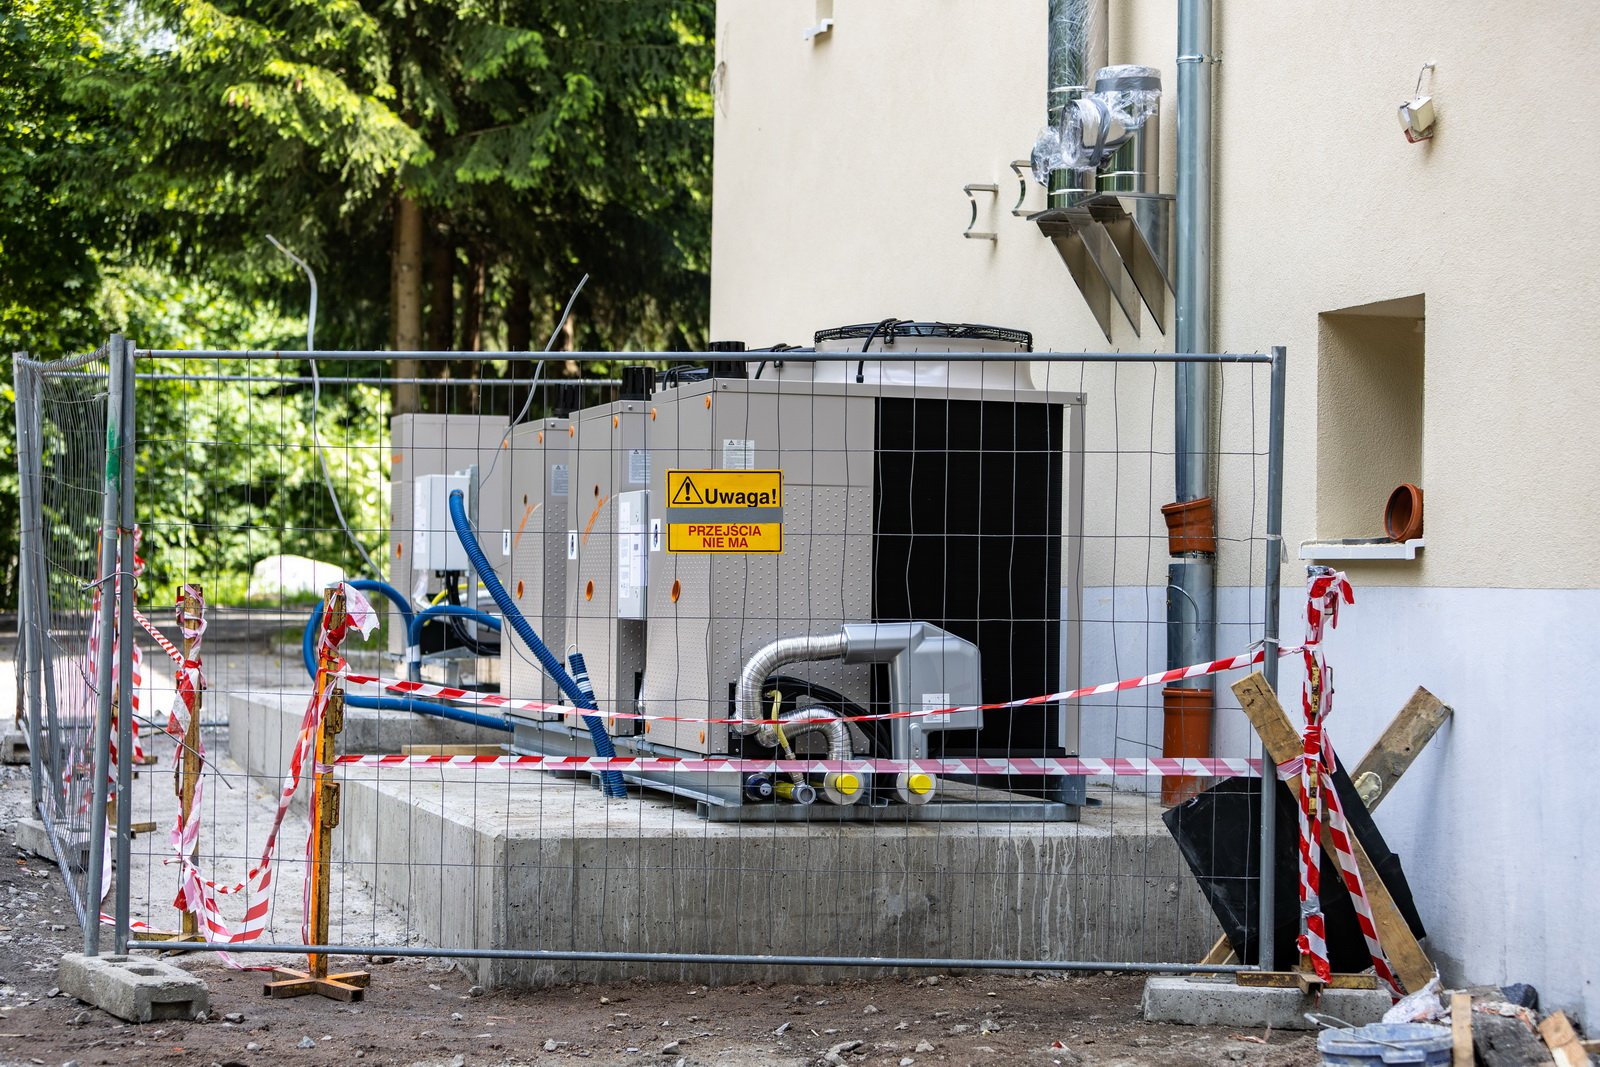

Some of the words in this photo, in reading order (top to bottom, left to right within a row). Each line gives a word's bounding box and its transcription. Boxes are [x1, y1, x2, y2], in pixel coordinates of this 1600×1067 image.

[705, 488, 777, 507] Uwaga!
[688, 524, 762, 537] PRZEJŚCIA
[702, 537, 725, 548] NIE
[728, 537, 749, 548] MA
